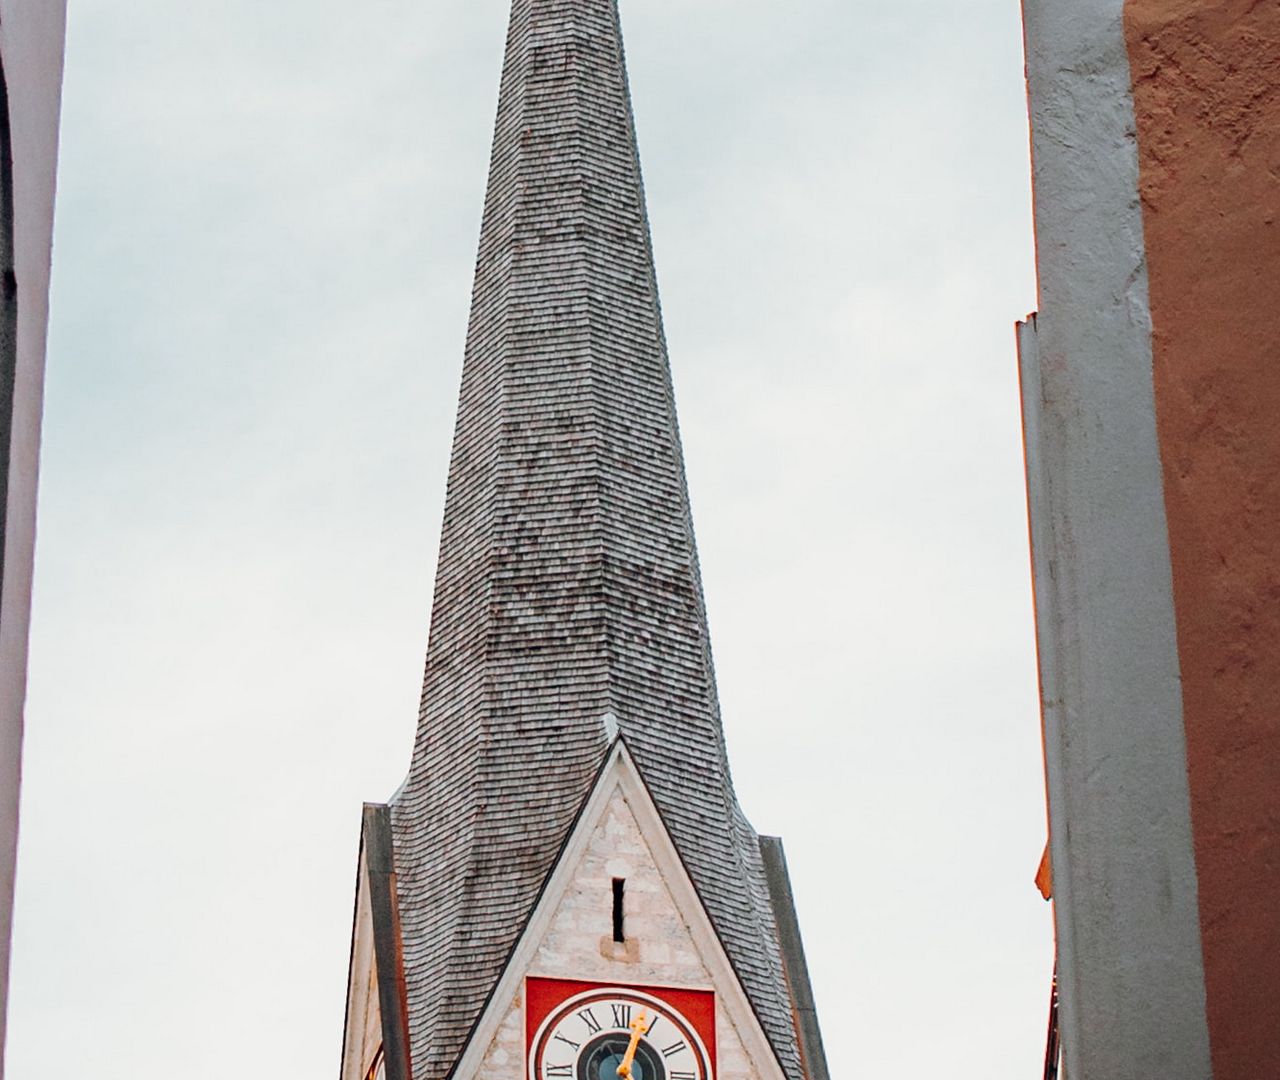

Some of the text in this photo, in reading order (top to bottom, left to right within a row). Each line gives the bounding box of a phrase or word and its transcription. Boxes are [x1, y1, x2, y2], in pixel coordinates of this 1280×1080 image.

[578, 1009, 602, 1035] XI
[611, 1004, 631, 1028] XII
[554, 1031, 580, 1051] X
[661, 1040, 686, 1057] II
